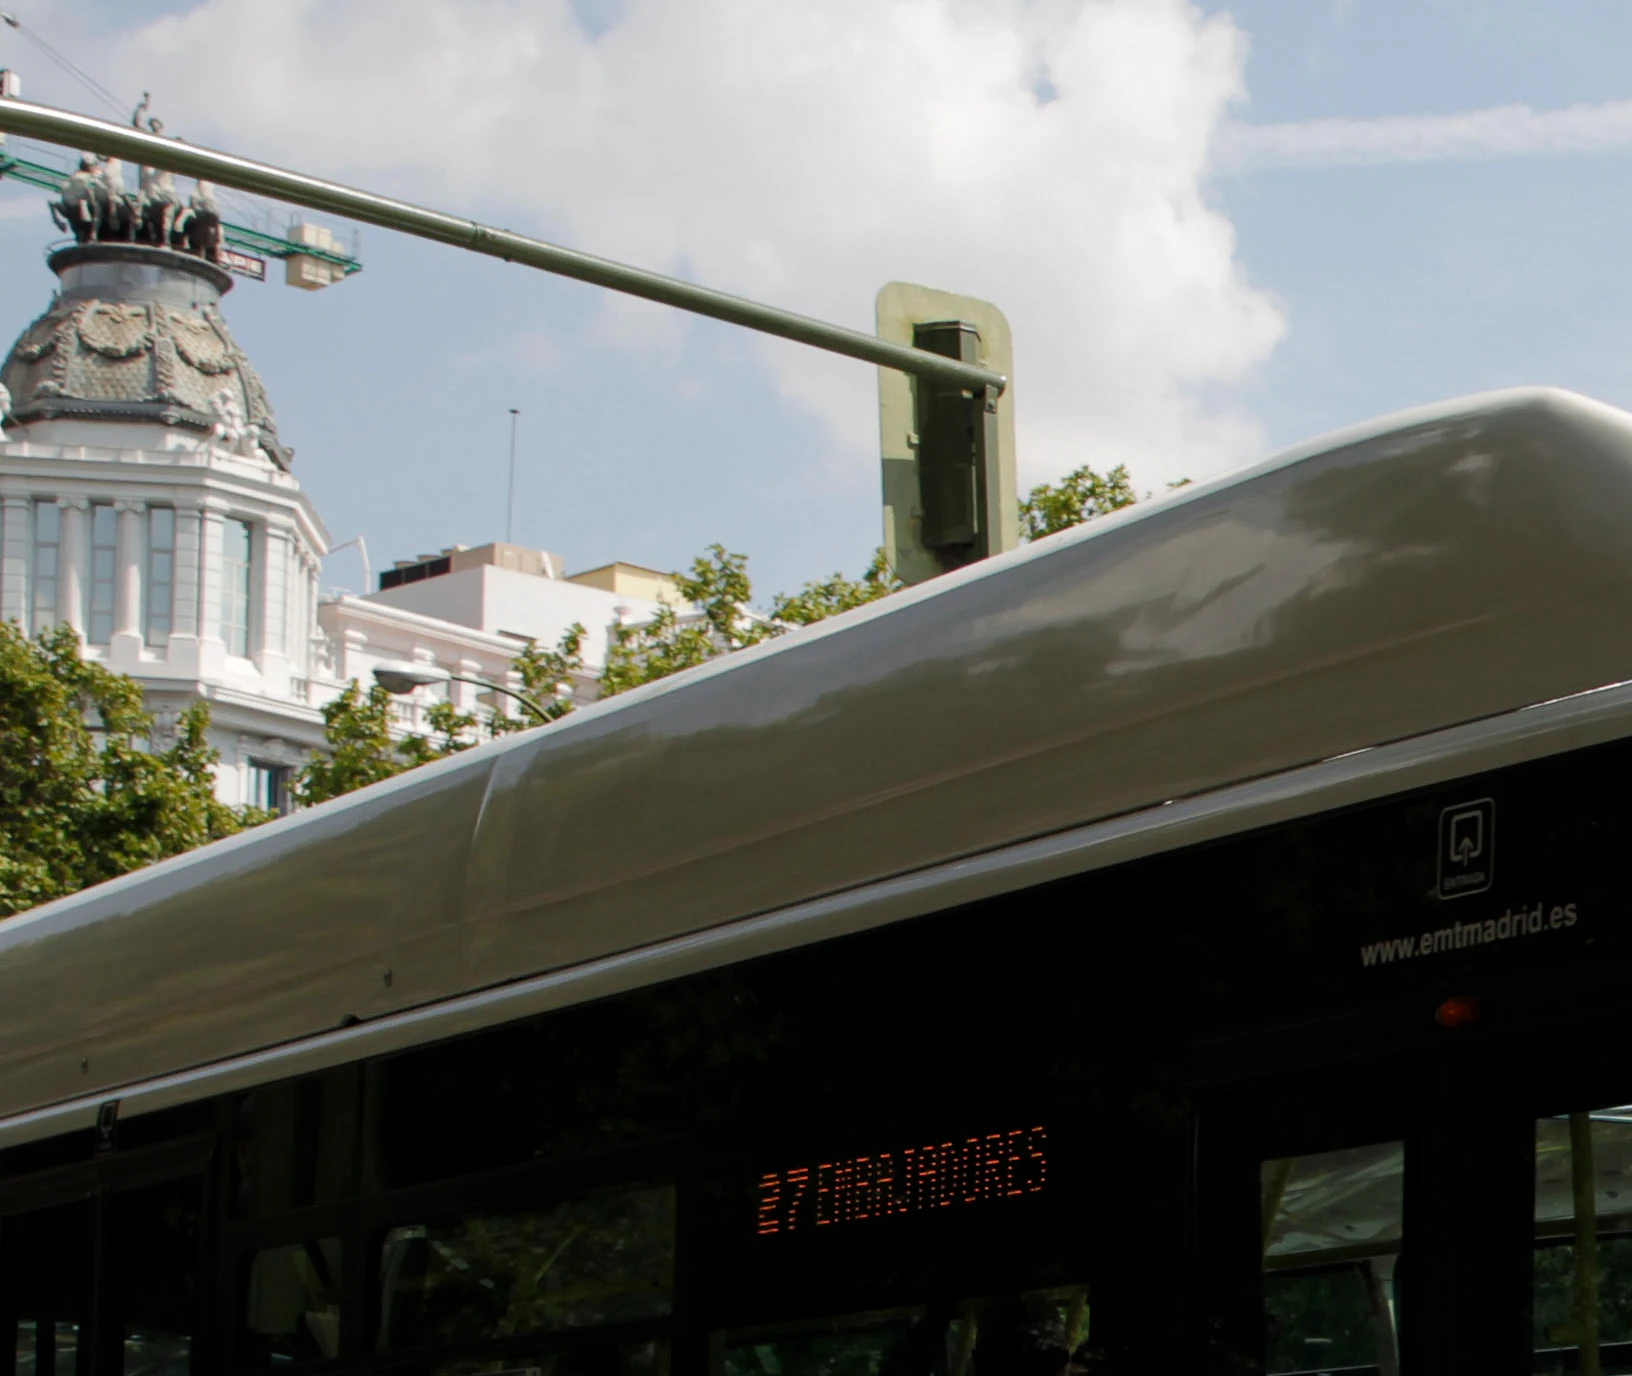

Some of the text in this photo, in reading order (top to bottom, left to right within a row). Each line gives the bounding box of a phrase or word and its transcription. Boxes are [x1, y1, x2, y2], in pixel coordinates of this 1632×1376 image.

[1360, 901, 1578, 967] www.emtmadrid.es
[756, 1126, 1048, 1235] 27 EMBAJADORES
